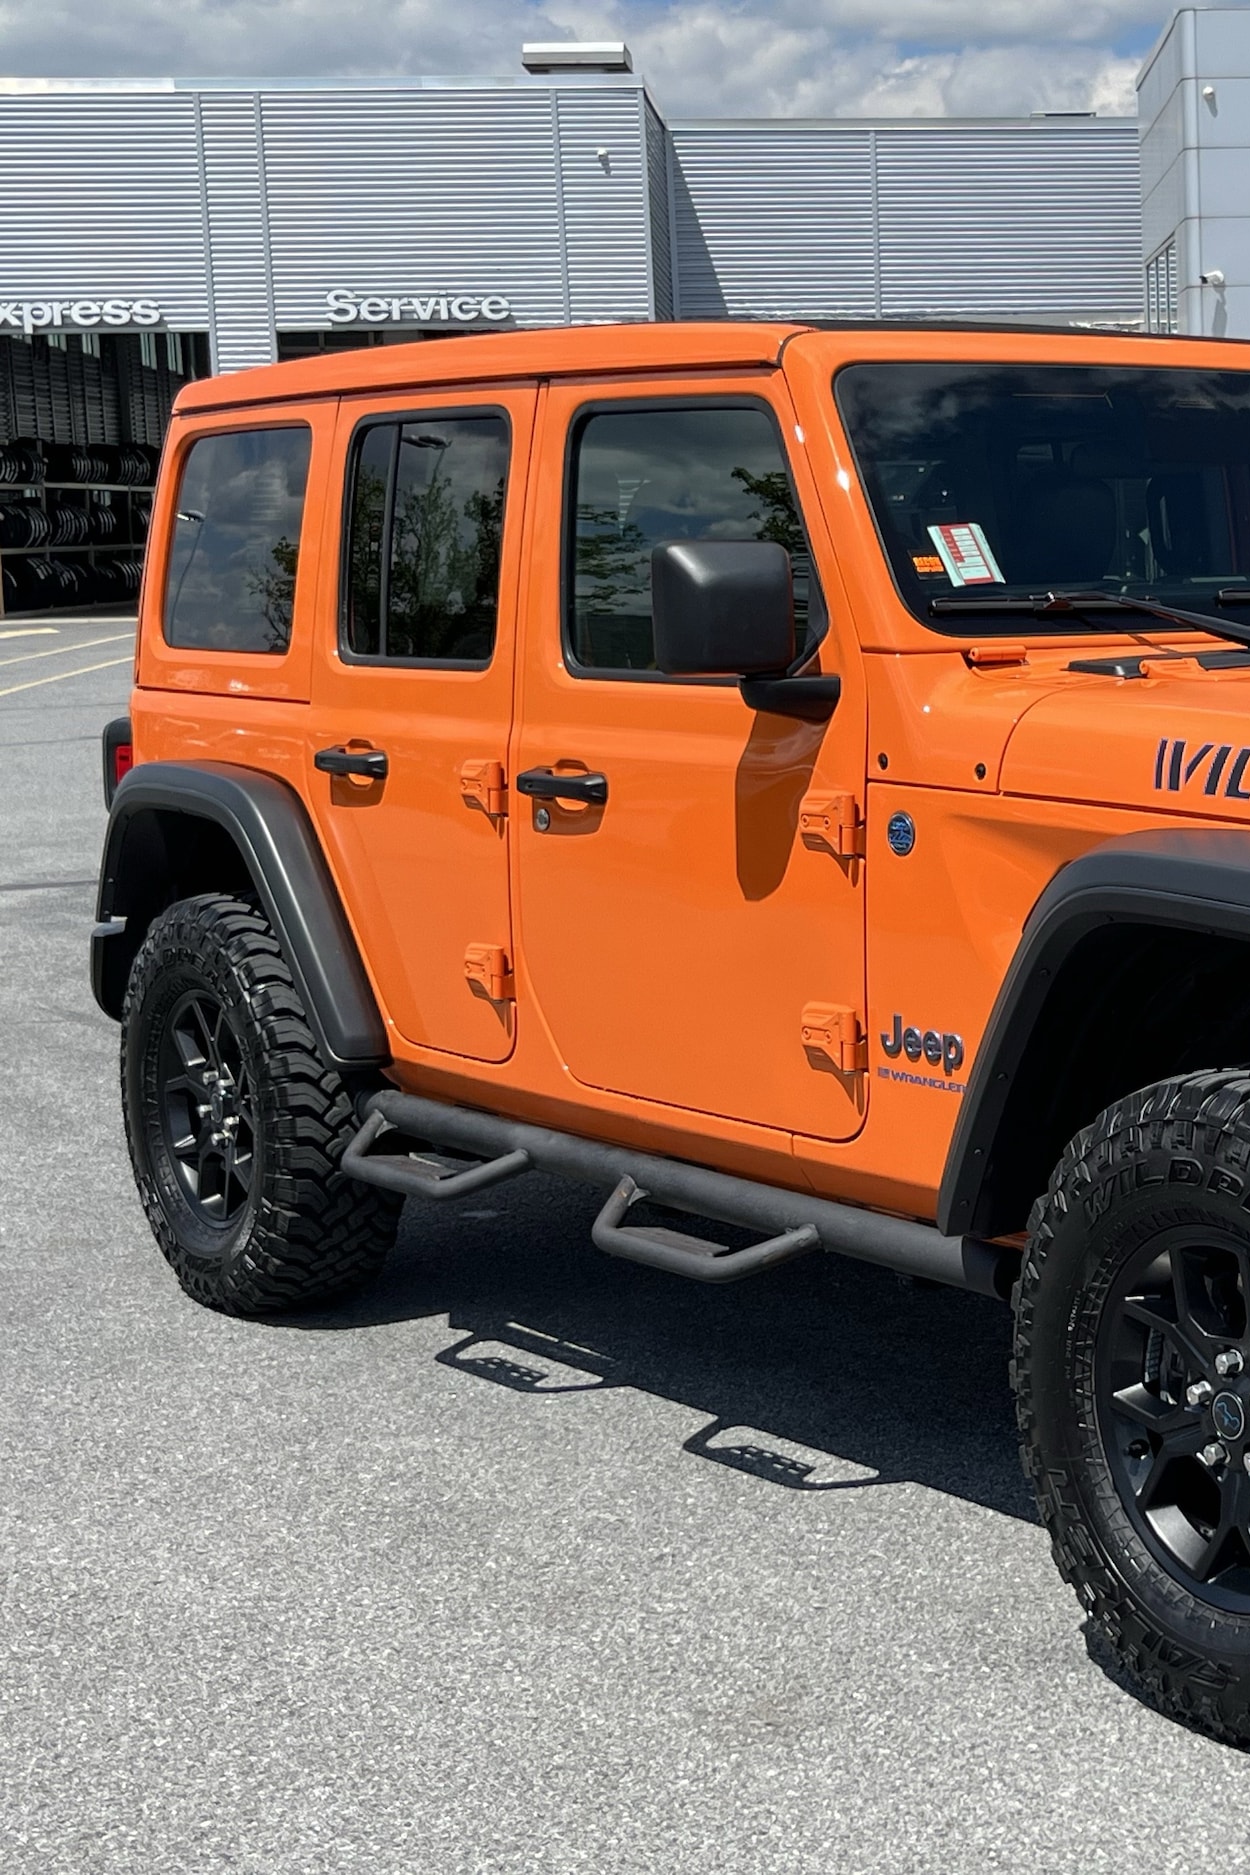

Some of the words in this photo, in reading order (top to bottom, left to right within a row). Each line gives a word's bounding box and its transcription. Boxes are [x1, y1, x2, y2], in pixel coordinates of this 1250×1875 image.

[326, 289, 511, 322] Service
[881, 1013, 964, 1076] Jeep
[892, 1070, 967, 1093] WRANGLER
